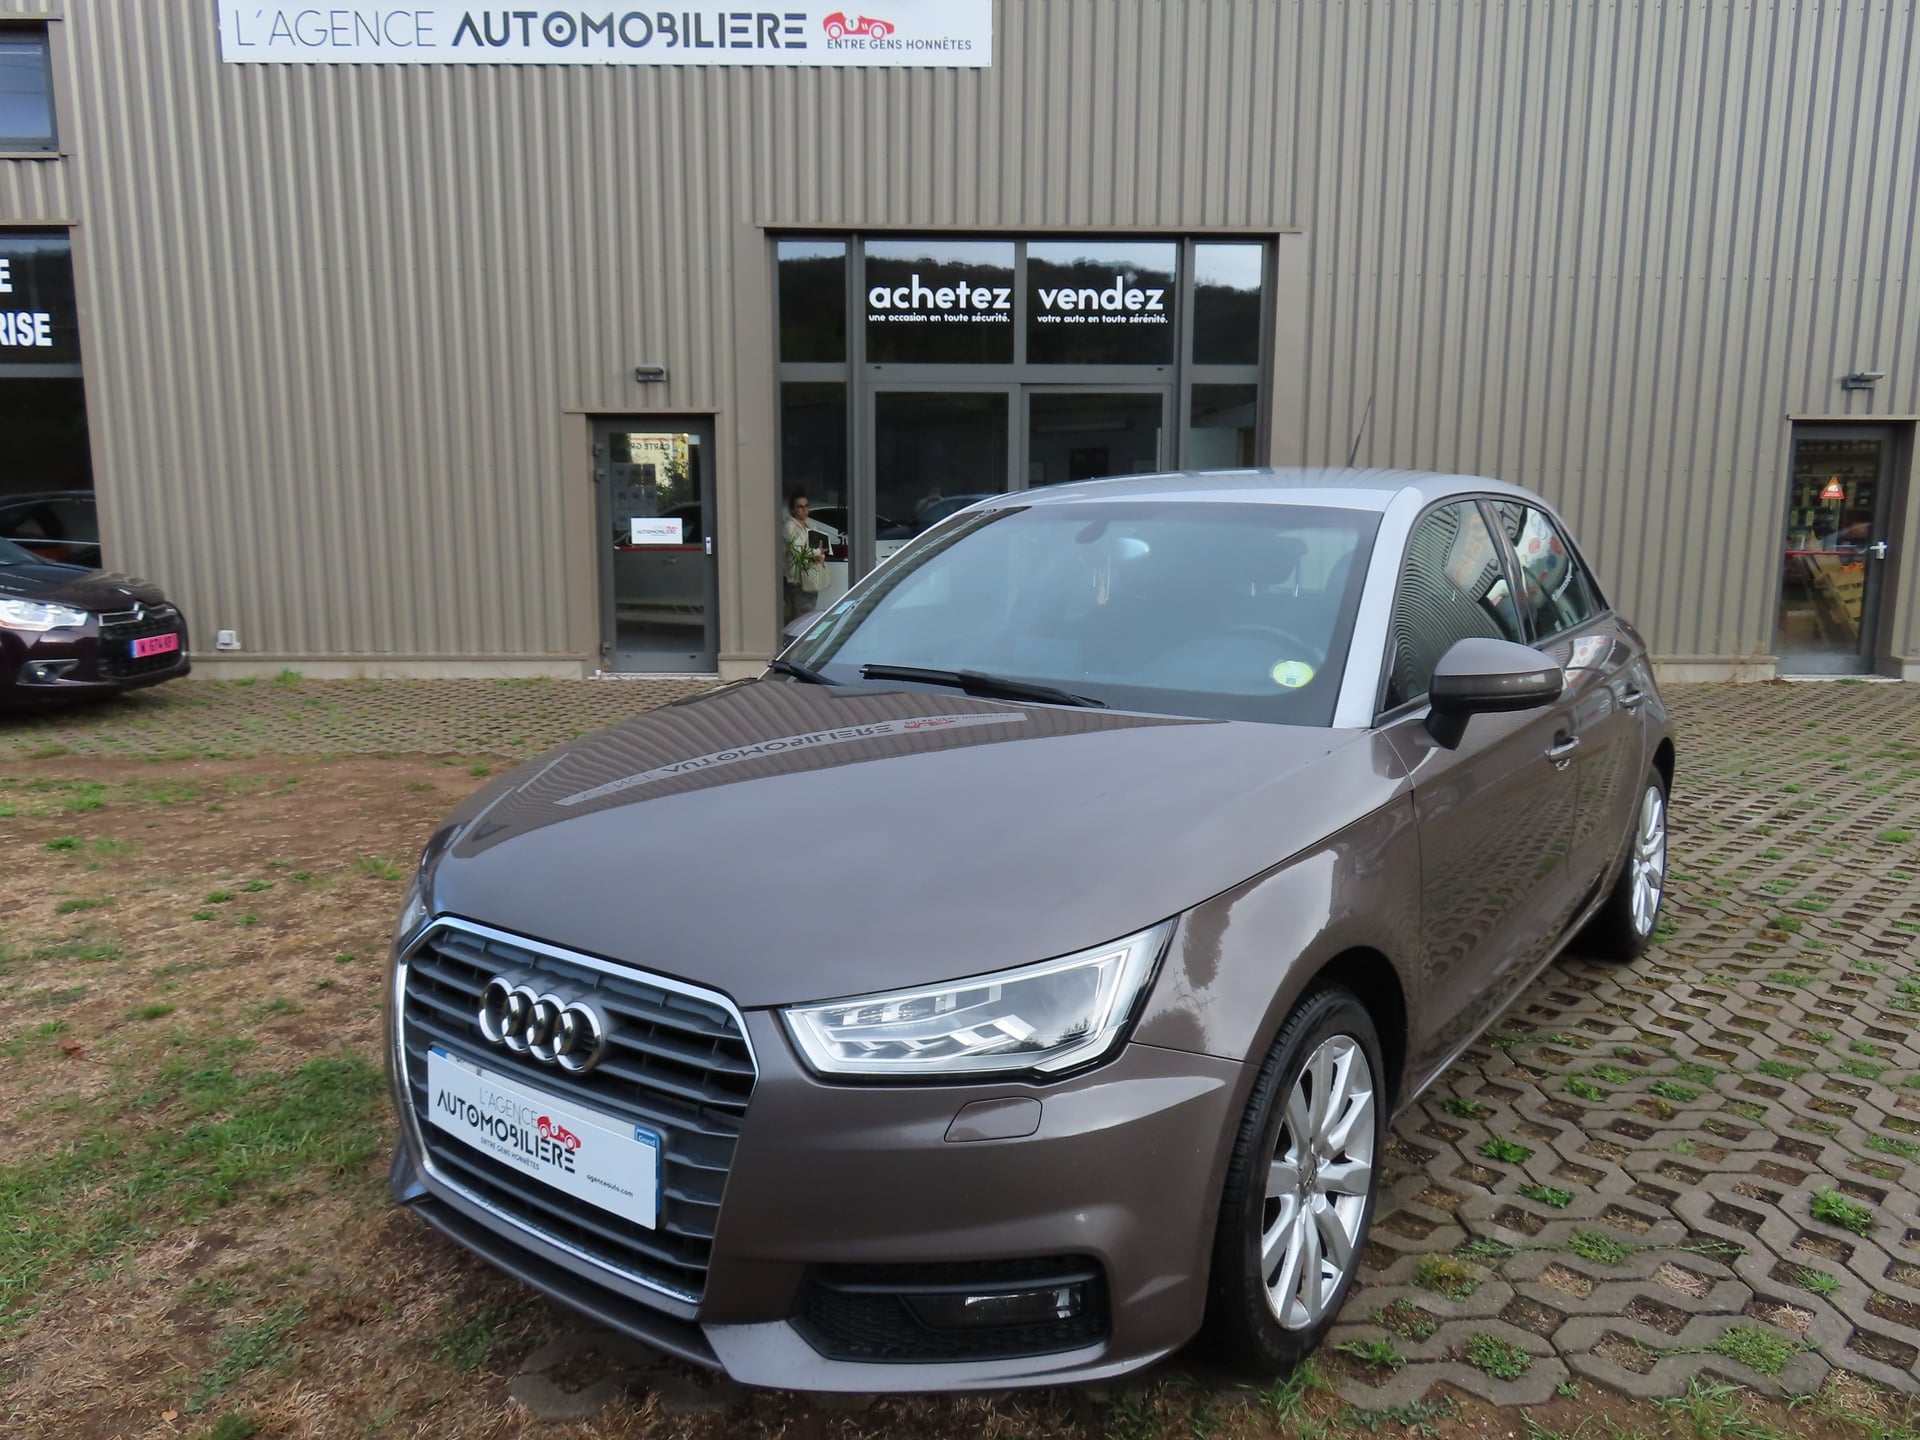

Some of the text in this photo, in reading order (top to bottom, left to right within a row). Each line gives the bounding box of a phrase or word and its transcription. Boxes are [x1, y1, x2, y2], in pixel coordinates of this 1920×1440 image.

[235, 10, 808, 49] L'AGENCE AUTOMOBILIERE
[827, 36, 972, 50] ENTRE GENS HONNÊTES
[868, 274, 1011, 309] achetez
[1038, 275, 1165, 310] vendez
[868, 312, 1010, 322] une occasion en toute sécurité.
[1037, 314, 1061, 323] votre
[1063, 314, 1085, 323] auto
[1102, 314, 1127, 323] toute
[1129, 313, 1168, 324] sérénité.
[479, 1087, 539, 1129] L'AGENCE
[437, 1088, 576, 1174] AUTOMOBILIERE
